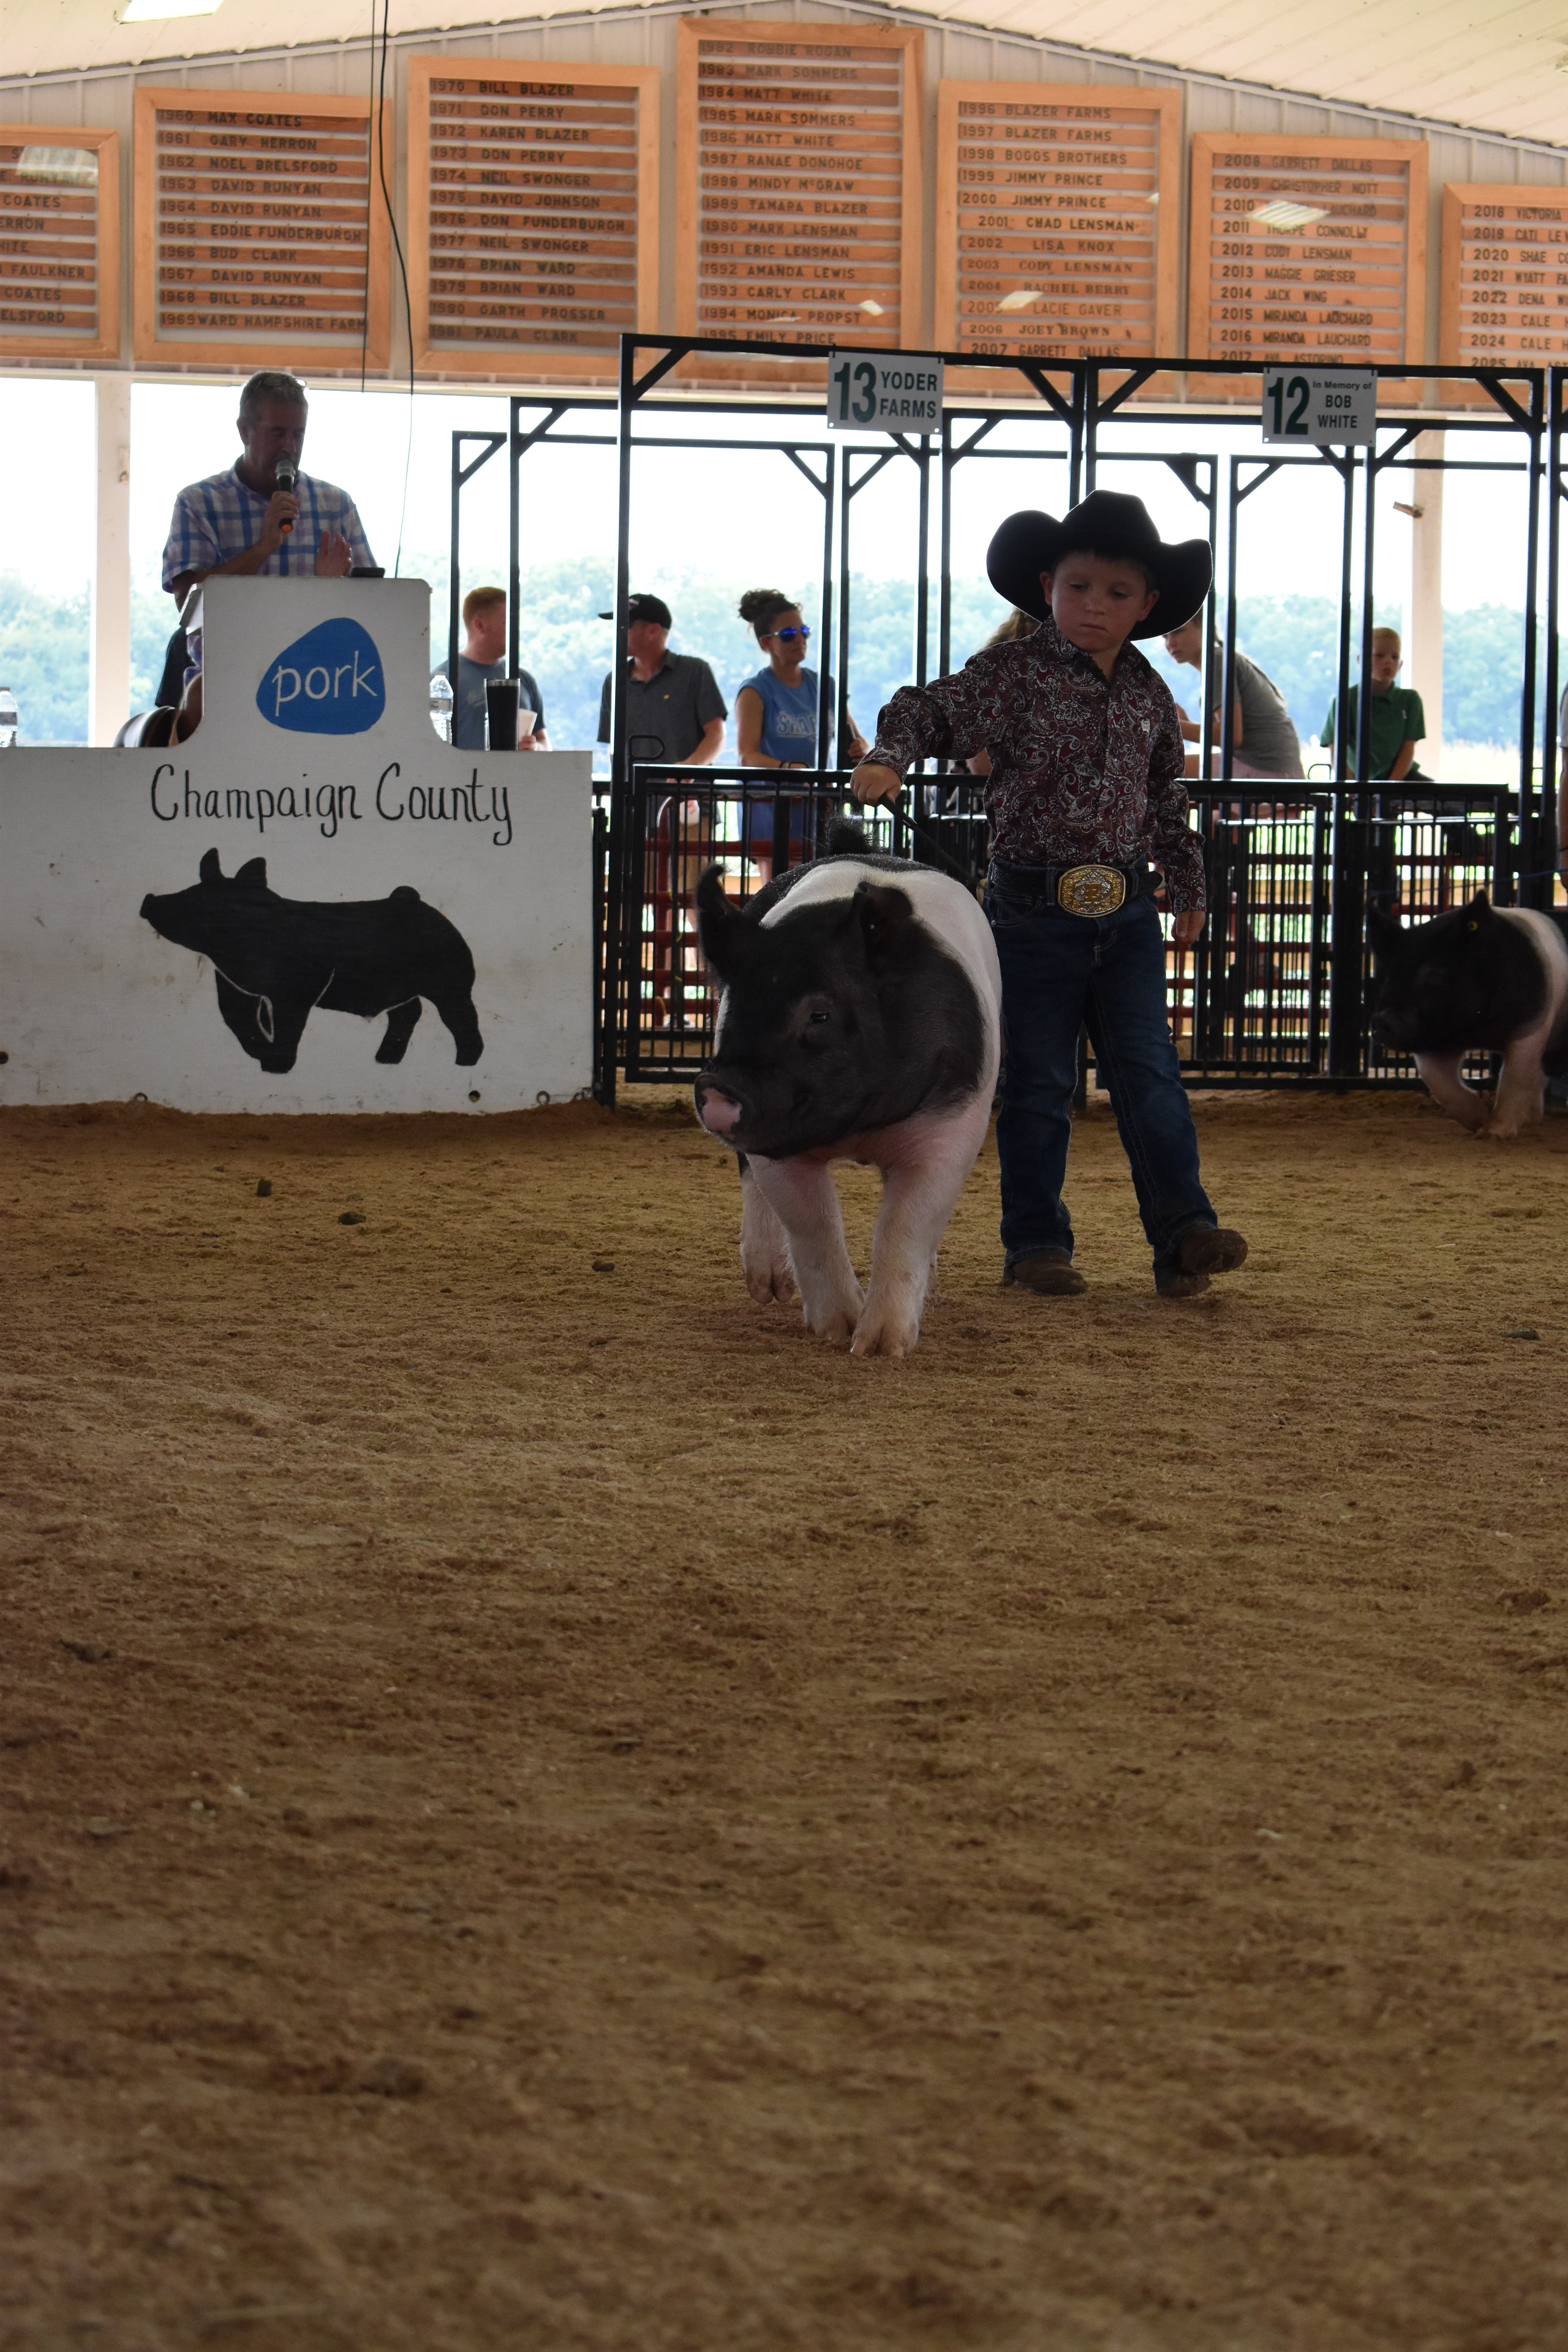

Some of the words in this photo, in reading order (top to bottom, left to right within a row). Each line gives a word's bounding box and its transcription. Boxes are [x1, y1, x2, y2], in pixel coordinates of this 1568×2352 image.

[432, 80, 465, 92] 1970
[479, 81, 509, 94] BILL
[520, 83, 575, 97] BLAZER
[701, 86, 734, 99] 1984
[744, 88, 781, 100] MATT
[791, 89, 832, 102] WHITE
[160, 110, 194, 123] 1960
[208, 111, 236, 124] MAX
[247, 113, 302, 127] COATES
[432, 103, 462, 115] 1971
[481, 105, 510, 117] DON
[519, 105, 564, 119] PERRY
[703, 110, 737, 122] 1985
[745, 111, 782, 124] MARK
[791, 113, 856, 127] SOMMERS
[963, 103, 995, 116] 1996
[1005, 104, 1058, 118] BLAZER
[1067, 106, 1111, 119] FARMS
[432, 125, 466, 138] 1972
[480, 126, 526, 140] KAREN
[535, 128, 589, 141] BLAZER
[704, 131, 737, 144] 1986
[745, 132, 783, 145] MATT
[794, 134, 835, 147] WHITE
[963, 125, 995, 138] 1997
[1005, 126, 1057, 140] BLAZER
[1067, 129, 1112, 142] FARMS
[159, 132, 190, 145] 1961
[209, 134, 247, 148] GARY
[260, 136, 317, 151] HERRON
[433, 147, 467, 159] 1973
[481, 148, 510, 161] DON
[521, 149, 566, 163] PERRY
[704, 153, 737, 166] 1987
[747, 154, 792, 168] RANAE
[799, 156, 863, 170] DONOHOE
[962, 148, 995, 160] 1998
[1005, 149, 1050, 162] BOGGS
[1058, 151, 1127, 165] BROTHERS
[160, 155, 195, 168] 1962
[209, 157, 246, 170] NOEL
[256, 159, 337, 173] BRELSFORD
[433, 169, 467, 182] 1974
[481, 171, 511, 183] NEIL
[522, 172, 591, 186] SWONGER
[963, 170, 995, 183] 1999
[1005, 171, 1046, 184] JIMMY
[1055, 173, 1103, 186] PRINCE
[162, 178, 196, 190] 1963
[211, 179, 254, 192] DAVID
[263, 181, 322, 195] RUNYAN
[3, 195, 61, 208] COATES
[431, 191, 466, 204] 1975
[481, 192, 523, 206] DAVID
[537, 194, 600, 208] JOHNSON
[705, 197, 738, 210] 1989
[750, 199, 804, 213] TAMARA
[814, 201, 868, 214] BLAZER
[963, 192, 997, 205] 2000
[1011, 194, 1052, 207] JIMMY
[1058, 195, 1106, 209] PRINCE
[1224, 199, 1255, 212] 2010
[162, 200, 195, 213] 1964
[211, 202, 254, 215] DAVID
[263, 203, 322, 217] RUNYAN
[1474, 205, 1504, 219] 2018
[1516, 206, 1562, 221] VICTORIA
[706, 220, 738, 233] 1990
[748, 222, 784, 235] MARK
[793, 223, 858, 238] LENSMAN
[978, 215, 1009, 228] 2001
[1027, 217, 1062, 230] CHAD
[1069, 218, 1134, 232] LENSMAN
[162, 223, 195, 236] 1965
[211, 225, 252, 238] EDDIE
[258, 227, 362, 242] FUNDERBURGH
[431, 235, 465, 248] 1977
[479, 237, 510, 250] NEIL
[521, 238, 589, 252] SWONGER
[706, 243, 734, 255] 1991
[745, 243, 775, 256] ERIC
[785, 244, 850, 258] LENSMAN
[968, 238, 1003, 249] 2002
[1033, 239, 1065, 251] LISA
[1078, 241, 1115, 252] KNOX
[161, 246, 195, 258] 1966
[210, 247, 238, 260] BUD
[252, 248, 297, 262] CLARK
[1223, 244, 1253, 257] 2012
[1265, 246, 1291, 258] CODY
[1302, 247, 1352, 260] LENSMAN
[1474, 248, 1509, 262] 2020
[1520, 249, 1547, 263] SHAE
[11, 264, 85, 278] FAULKNER
[704, 263, 738, 276] 1992
[747, 265, 804, 278] AMANDA
[814, 266, 856, 280] LEWIS
[968, 258, 1000, 270] 2003
[1019, 260, 1052, 271] CODY
[1065, 260, 1133, 273] LENSMAN
[161, 268, 195, 281] 1967
[211, 270, 254, 283] DAVID
[263, 271, 322, 285] RUNYAN
[1223, 265, 1253, 279] 2013
[1265, 267, 1302, 281] MAGGIE
[1313, 269, 1356, 283] GRIESER
[1472, 269, 1504, 282] 2021
[1515, 271, 1545, 284] WYATT
[4, 286, 61, 301] COATES
[431, 281, 466, 293] 1979
[480, 282, 521, 295] BRIAN
[537, 283, 575, 296] WARD
[704, 285, 737, 297] 1993
[747, 286, 792, 299] CARLY
[802, 287, 846, 301] CLARK
[968, 281, 1001, 292] 2004
[1024, 282, 1079, 293] RACHEL
[1086, 283, 1130, 295] BERRY
[1221, 287, 1252, 300] 2014
[1264, 288, 1291, 301] JACK
[1303, 290, 1327, 303] WING
[160, 291, 195, 304] 1968
[209, 292, 240, 305] BILL
[251, 293, 306, 307] BLAZER
[1472, 290, 1507, 304] 2022
[1518, 292, 1545, 306] DENA
[1221, 307, 1253, 321] 2015
[1263, 309, 1308, 323] MIRANDA
[1472, 312, 1507, 326] 2023
[1521, 314, 1550, 327] CALE
[970, 324, 1003, 334] 2006
[1019, 325, 1054, 336] JOEY
[1060, 326, 1110, 337] BROWN
[1471, 334, 1506, 349] 2024
[1520, 336, 1551, 350] CALE
[971, 343, 1007, 356] 2007
[1019, 344, 1067, 357] GARRETT
[1079, 345, 1120, 358] DALLAS
[881, 371, 937, 391] YODER
[1325, 382, 1360, 391] Memory
[834, 362, 876, 423] 13
[880, 399, 936, 418] FARMS
[1268, 376, 1310, 435] 12
[1325, 395, 1351, 408] BOB
[1318, 415, 1357, 428] WHITE
[271, 650, 377, 717] pork
[151, 764, 363, 838] Champaign
[376, 763, 512, 845] County
